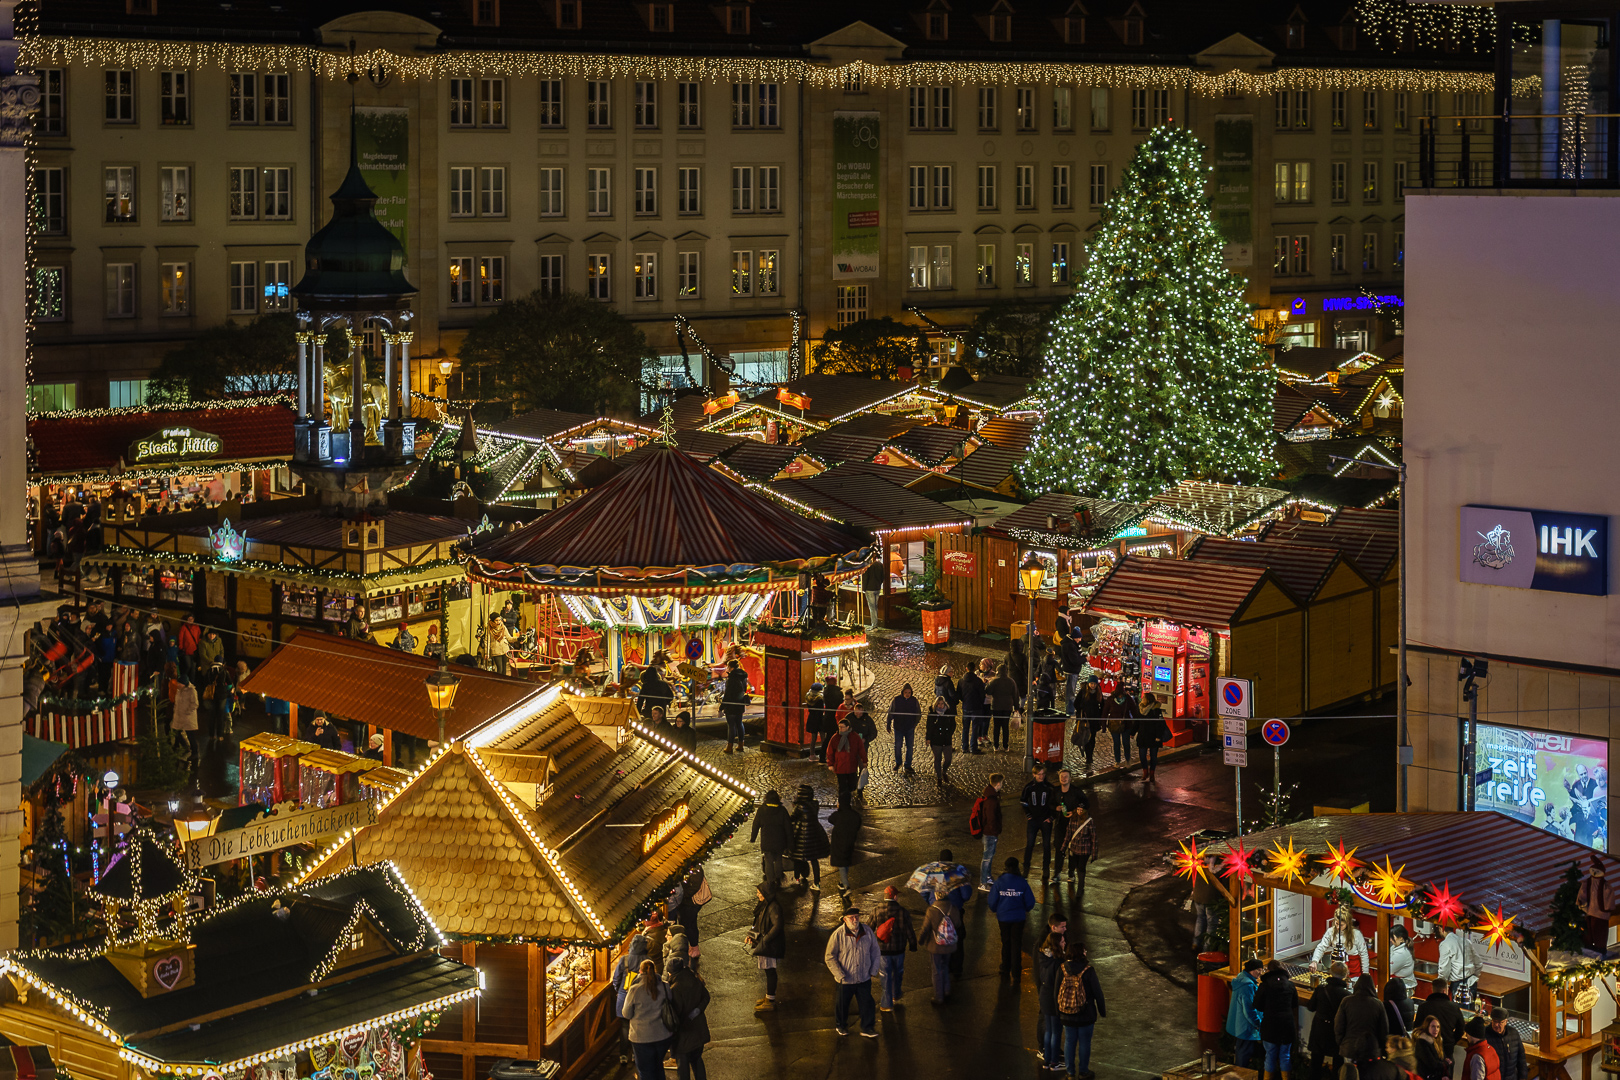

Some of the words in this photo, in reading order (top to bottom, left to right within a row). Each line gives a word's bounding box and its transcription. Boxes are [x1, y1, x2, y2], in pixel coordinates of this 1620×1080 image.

[362, 152, 398, 161] Magdeburger
[836, 162, 847, 170] Die
[848, 162, 871, 170] WOBAU
[836, 172, 860, 181] begrüßt
[860, 172, 871, 180] alle
[836, 182, 864, 190] Besucher
[864, 182, 874, 190] der
[836, 191, 878, 200] Märchengasse.
[853, 265, 877, 273] WOBAU
[136, 439, 178, 462] Steak
[180, 437, 219, 456] Hütte
[1541, 525, 1598, 558] IHK
[1162, 621, 1180, 632] Foto
[687, 667, 698, 677] WC
[1225, 707, 1241, 716] ZONE
[1486, 743, 1538, 756] magdeburger
[1488, 756, 1538, 780] zeit
[209, 837, 233, 861] Die
[238, 806, 360, 854] Lebkuchenbäckerei
